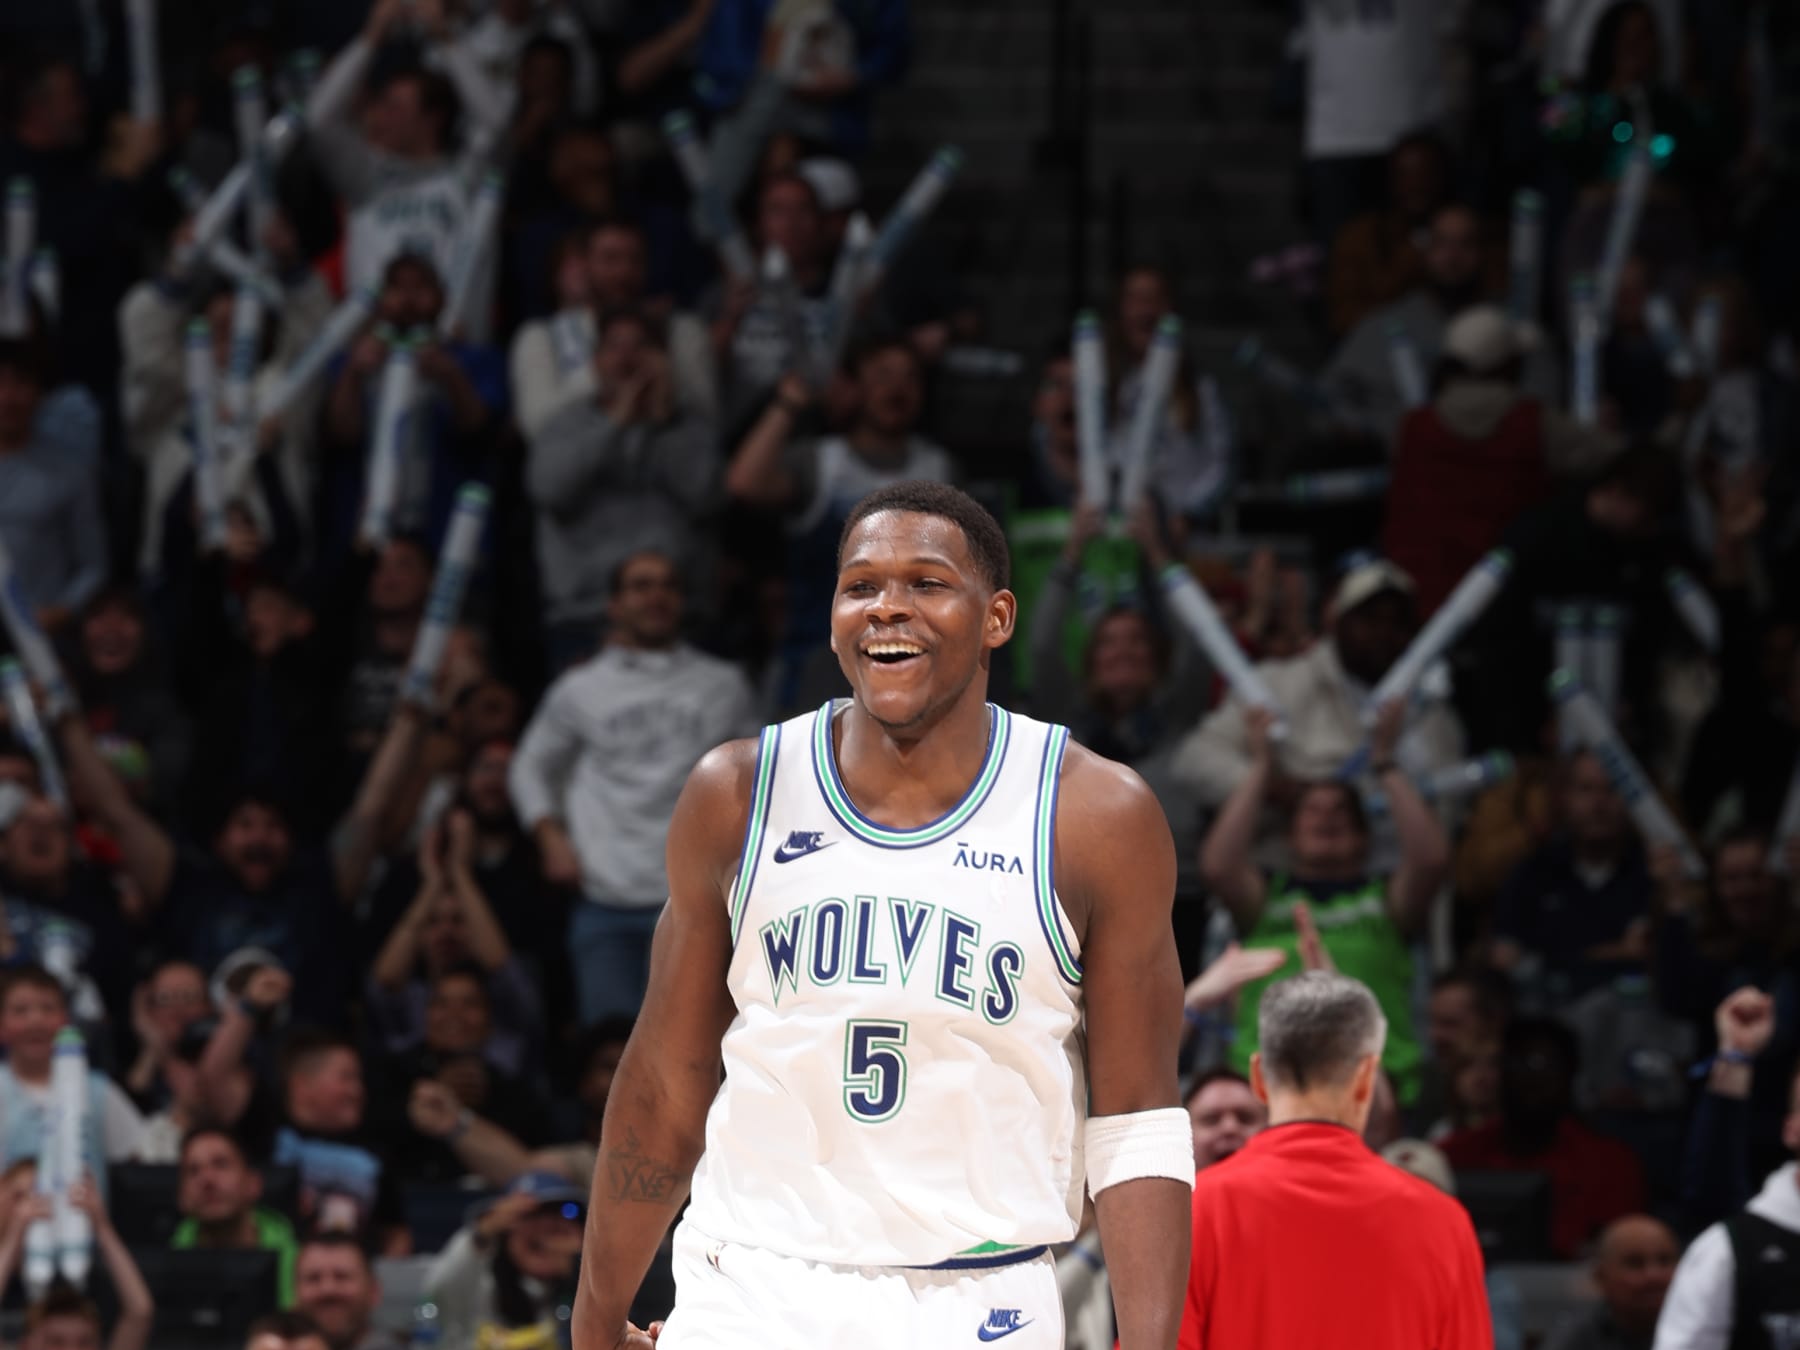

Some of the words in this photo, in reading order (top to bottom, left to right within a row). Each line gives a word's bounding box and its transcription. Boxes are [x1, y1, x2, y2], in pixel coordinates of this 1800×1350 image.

[784, 830, 825, 850] NIKE
[758, 895, 1025, 1026] WOLVES
[843, 1018, 909, 1124] 5
[986, 1308, 1022, 1329] NIKE
